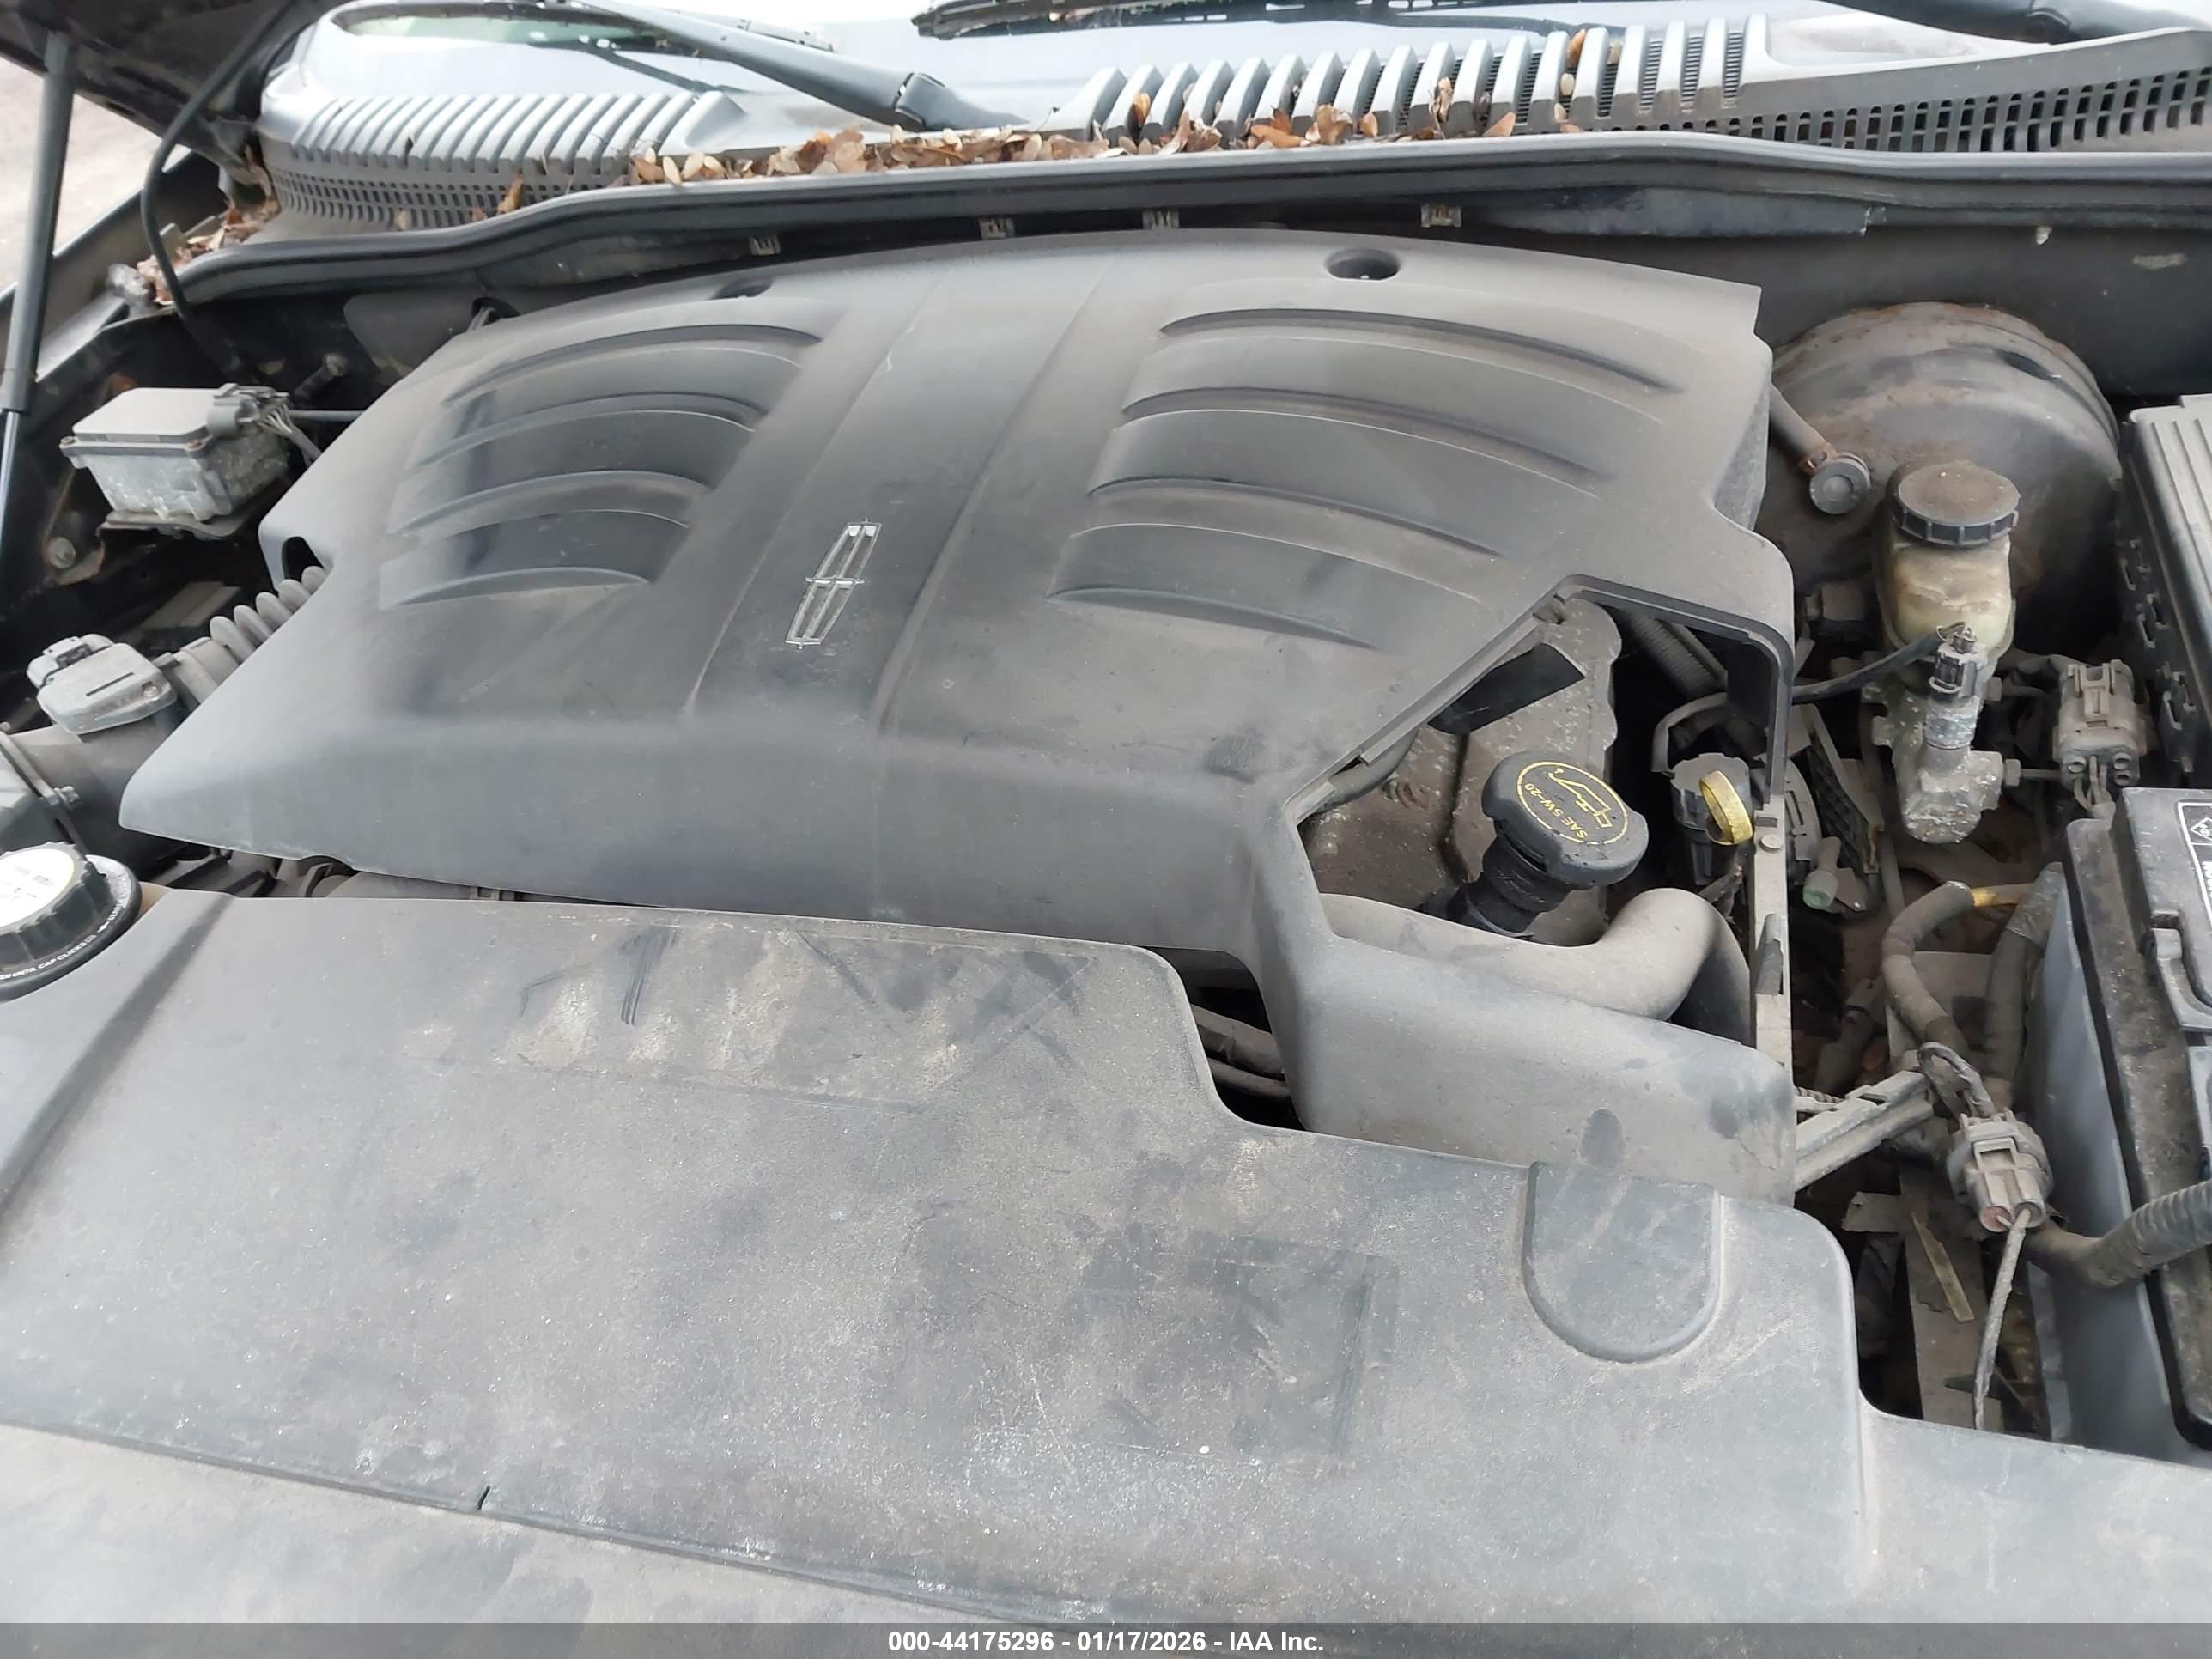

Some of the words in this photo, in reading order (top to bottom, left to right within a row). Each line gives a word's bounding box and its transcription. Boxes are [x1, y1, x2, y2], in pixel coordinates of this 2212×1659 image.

[1524, 782, 1564, 817] 5W-20
[1560, 817, 1589, 839] SAE
[38, 958, 57, 969] CAP
[57, 941, 86, 961] CLICKS
